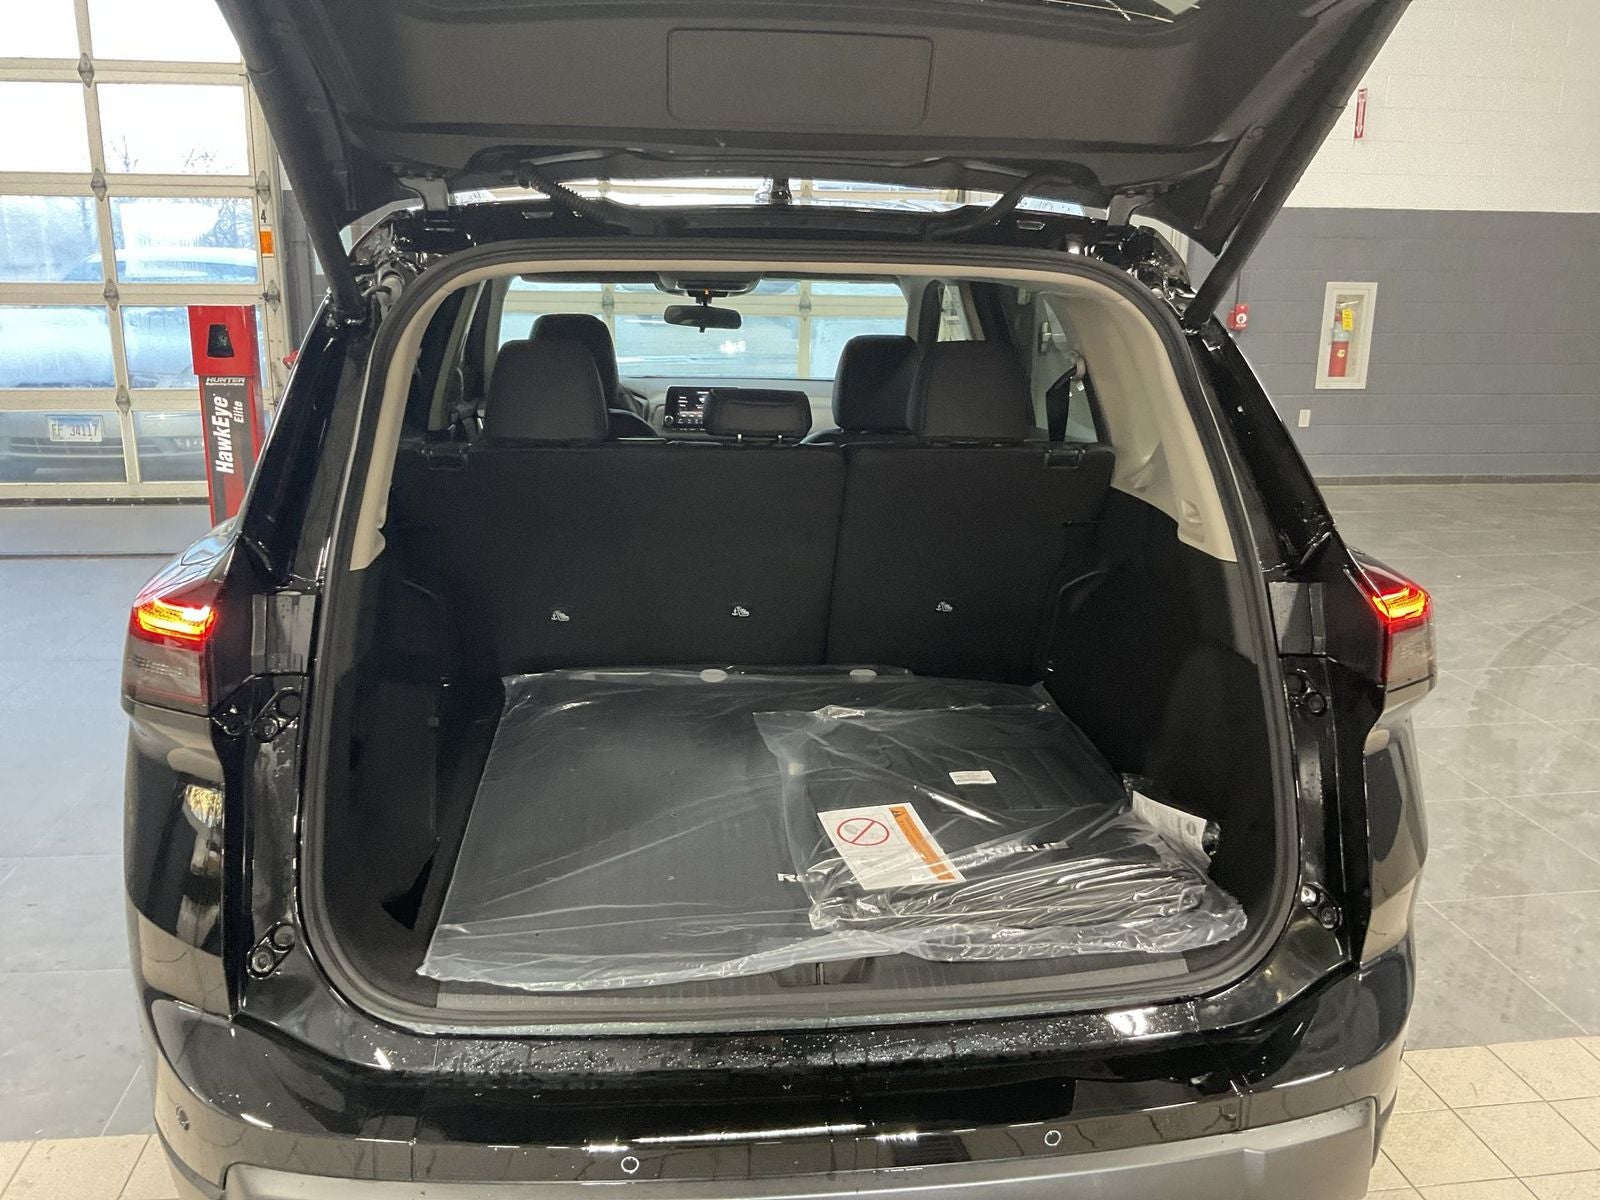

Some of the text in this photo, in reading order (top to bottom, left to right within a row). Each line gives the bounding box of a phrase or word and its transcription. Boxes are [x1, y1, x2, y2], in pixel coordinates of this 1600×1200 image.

[260, 209, 267, 223] 4
[205, 377, 245, 386] HUNTER
[233, 401, 245, 424] Elite
[212, 396, 234, 474] HawkEye
